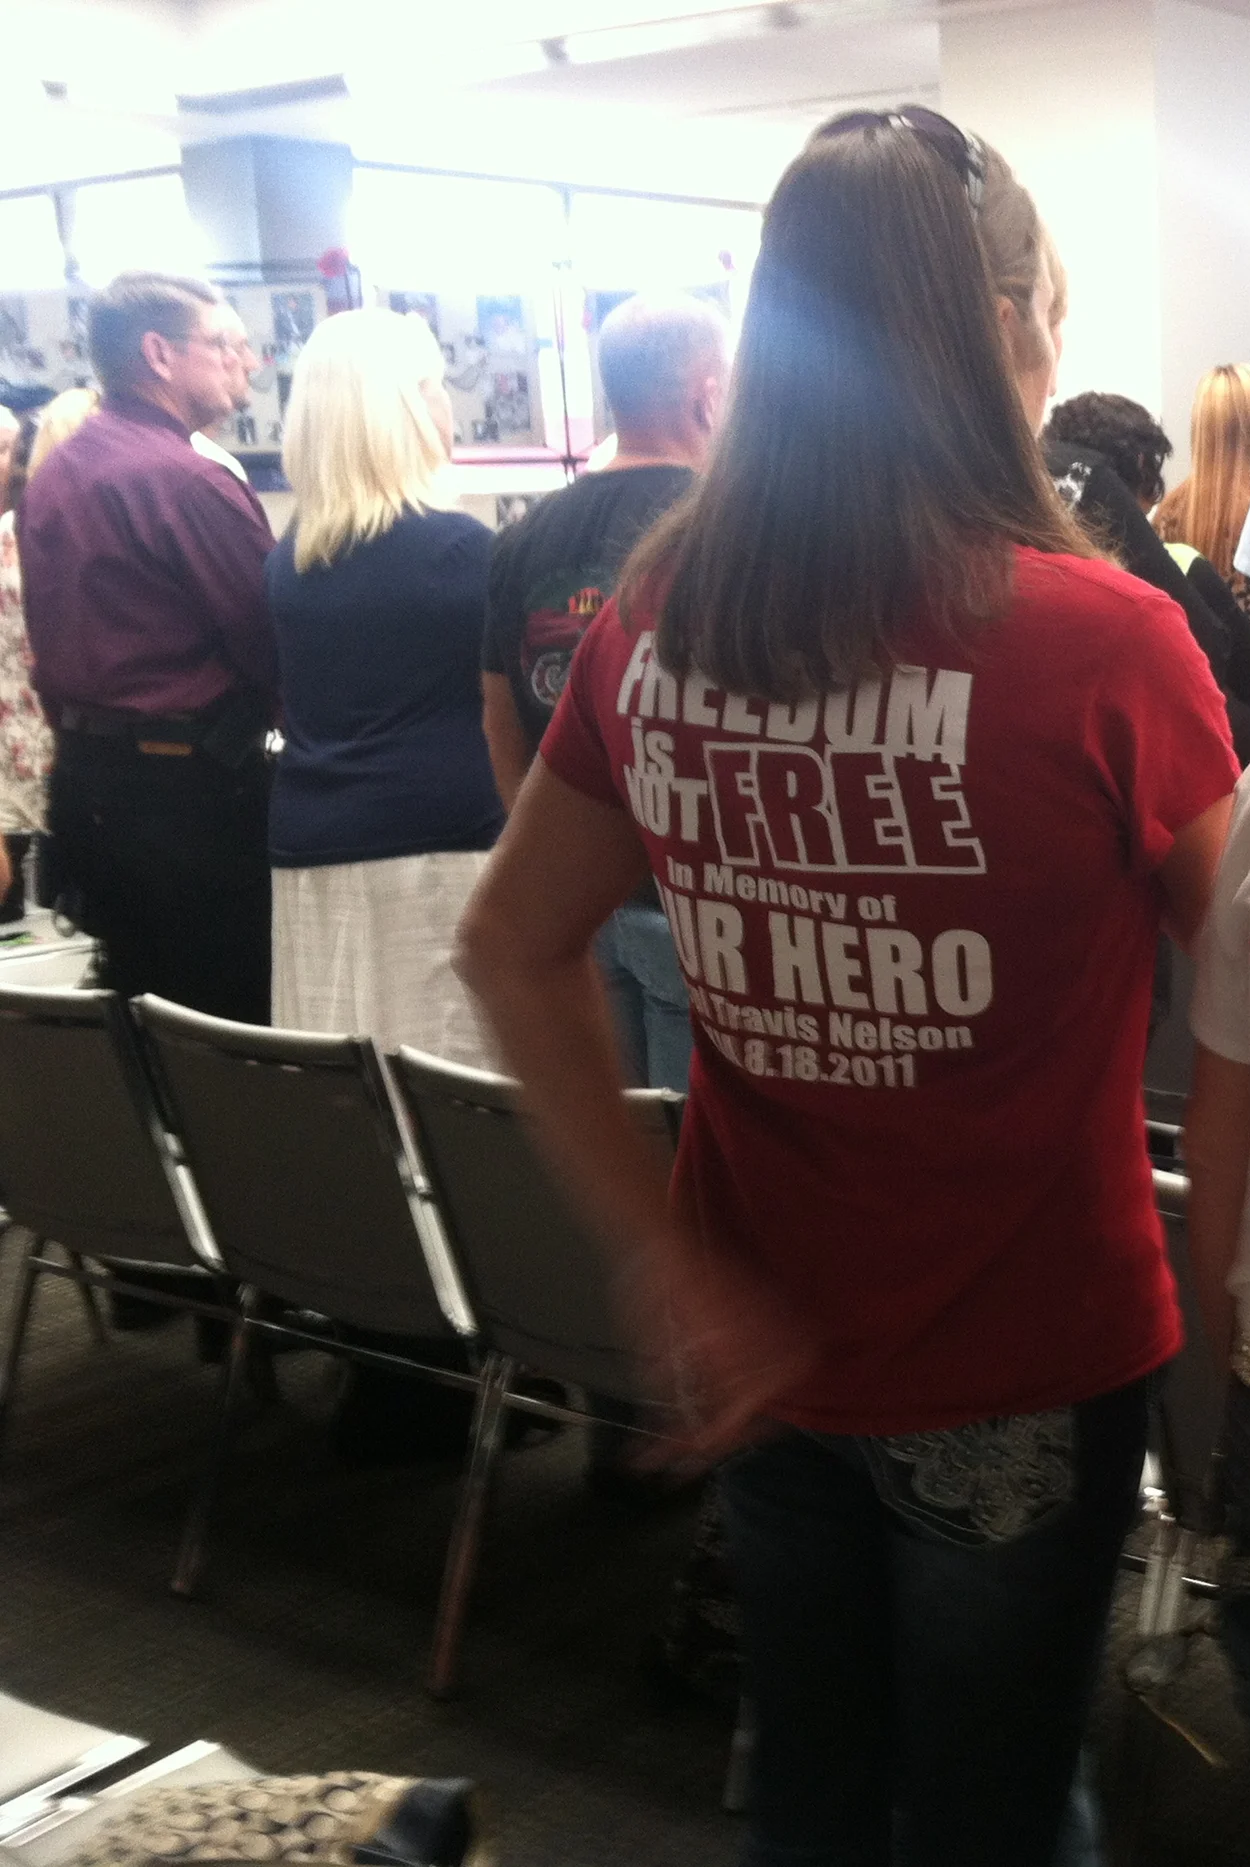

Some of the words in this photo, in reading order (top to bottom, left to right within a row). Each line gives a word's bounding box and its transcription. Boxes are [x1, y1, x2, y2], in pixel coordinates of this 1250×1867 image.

[630, 715, 676, 777] is
[702, 740, 987, 876] FREE
[666, 854, 693, 890] In
[703, 862, 849, 922] Memory
[857, 895, 899, 924] of
[653, 872, 748, 995] UR
[768, 908, 993, 1018] HERO
[708, 990, 820, 1047] Travis
[828, 1019, 974, 1053] Nelson
[743, 1038, 917, 1089] 8.18.2011
